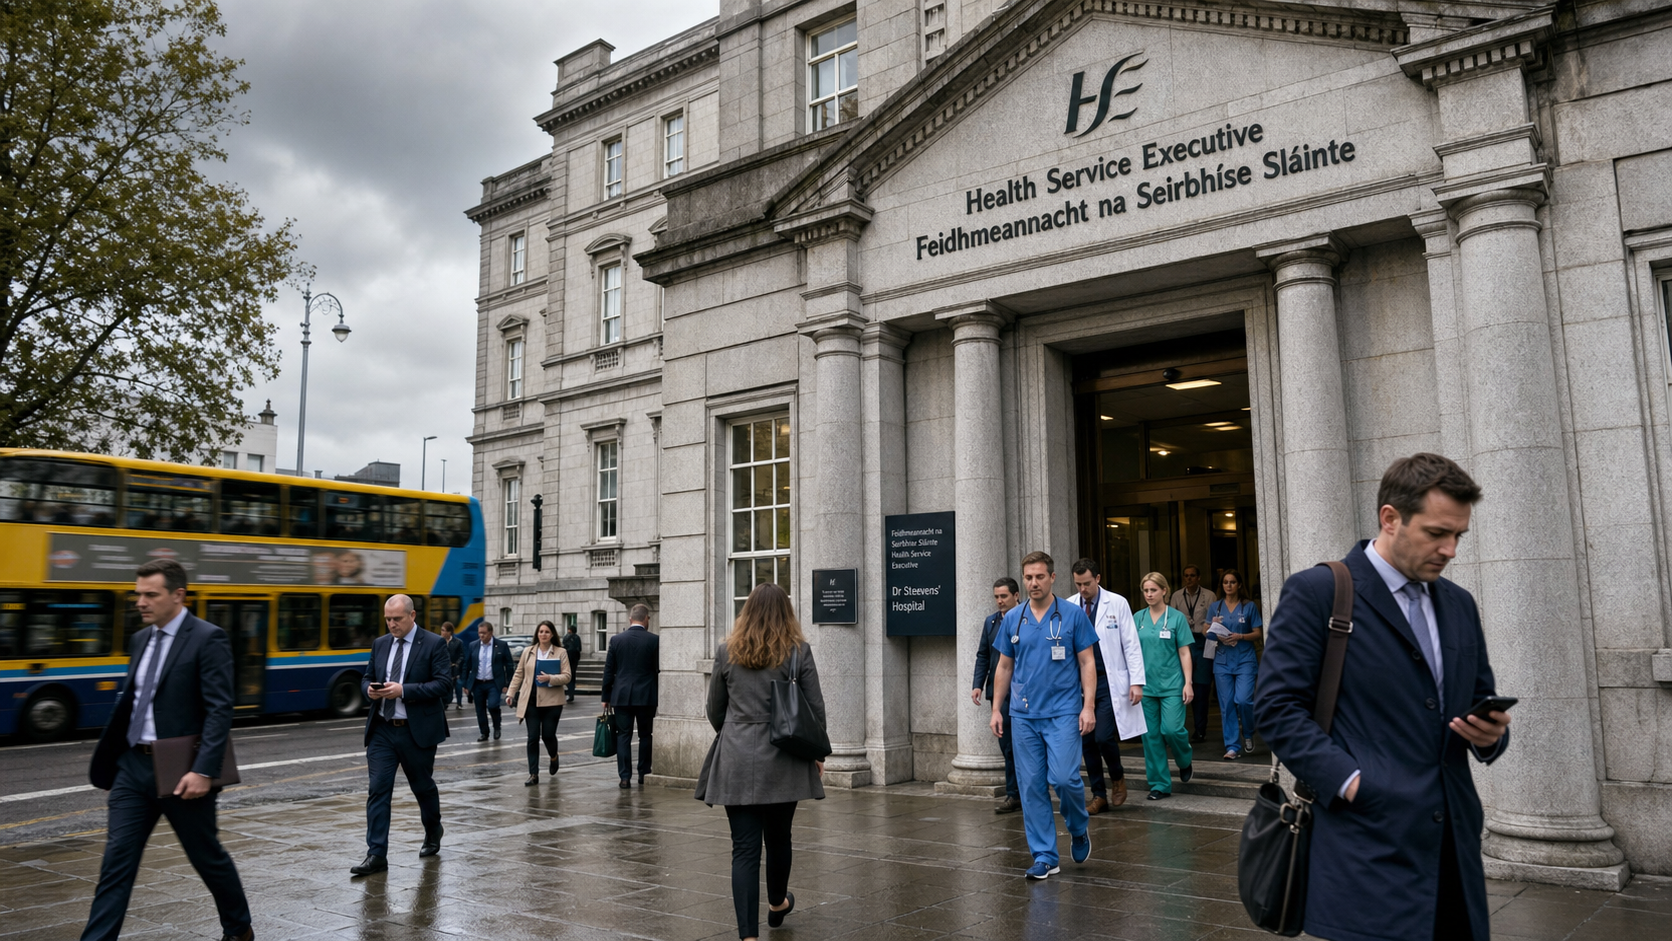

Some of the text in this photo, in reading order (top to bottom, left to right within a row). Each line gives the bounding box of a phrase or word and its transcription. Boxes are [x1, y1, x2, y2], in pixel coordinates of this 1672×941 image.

[966, 123, 1264, 215] Health Service Executive
[916, 141, 1356, 261] Feidhmeannacht na Seirbhíse Sláinte
[892, 586, 902, 596] Dr
[892, 600, 925, 614] Hospital
